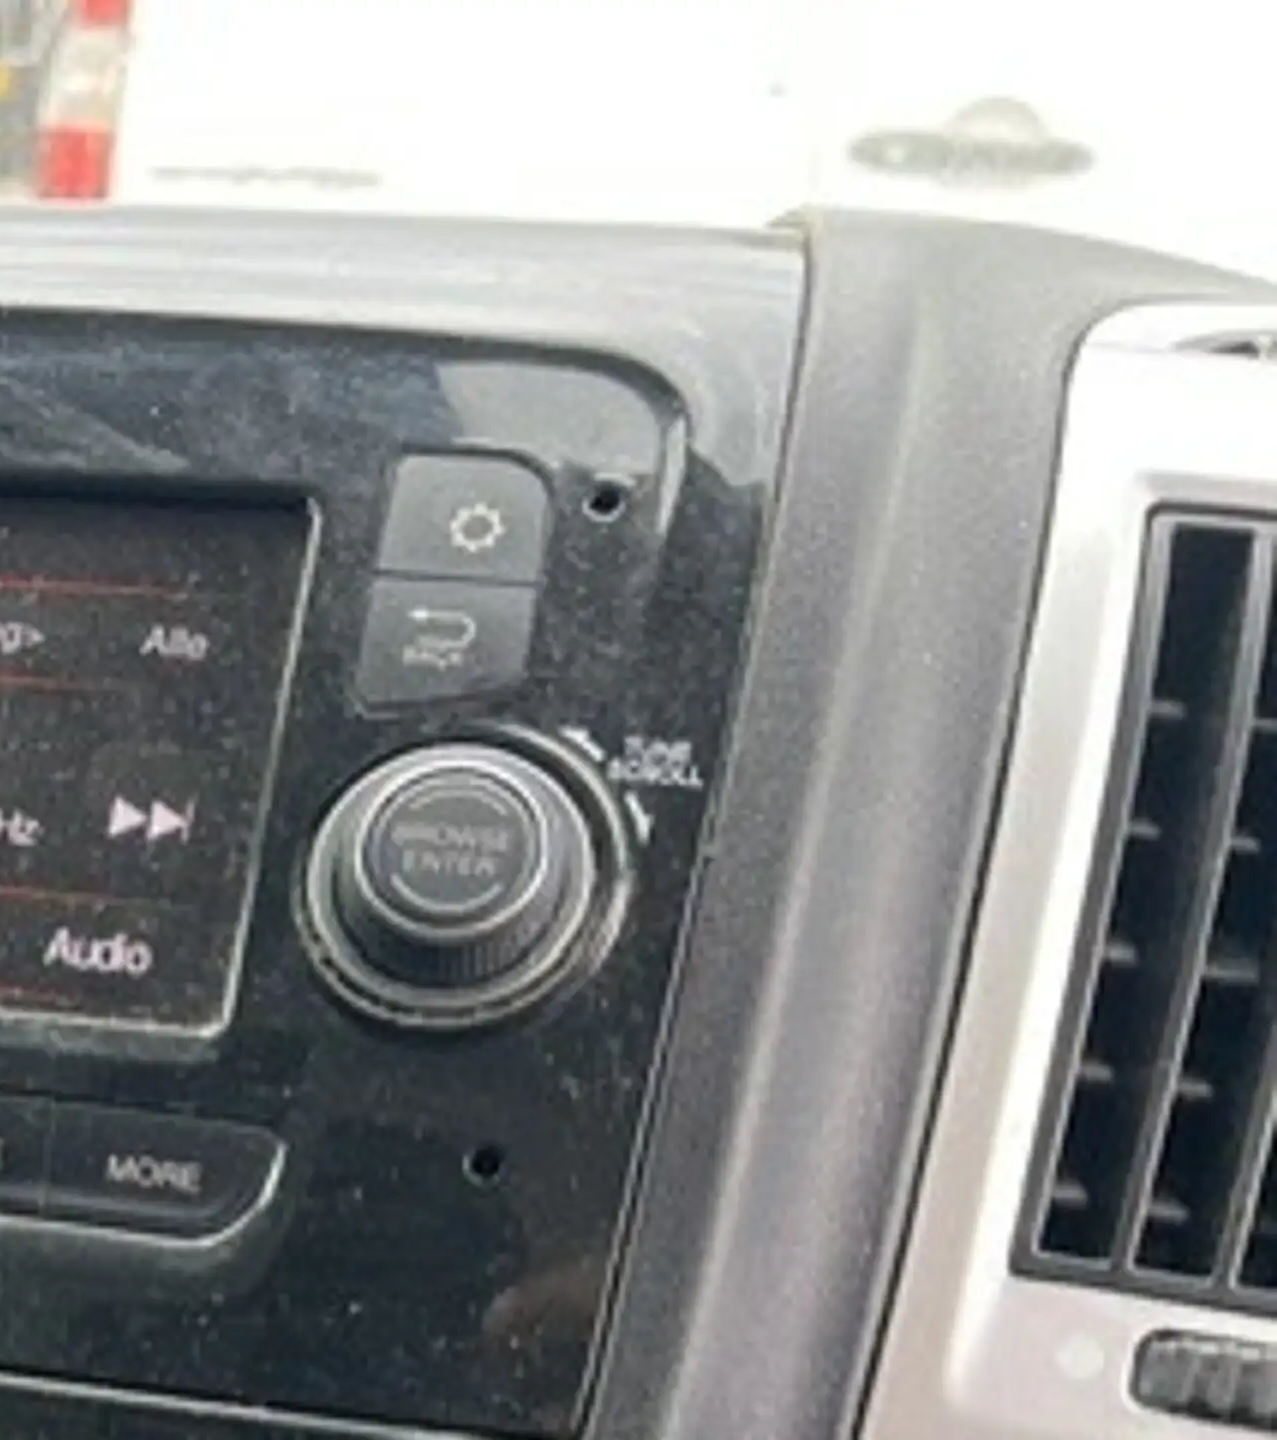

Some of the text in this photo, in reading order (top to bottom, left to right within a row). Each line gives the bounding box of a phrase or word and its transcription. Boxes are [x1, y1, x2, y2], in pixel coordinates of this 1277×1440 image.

[140, 624, 210, 662] Alle
[43, 927, 153, 976] Audio
[106, 1153, 202, 1194] MORE
